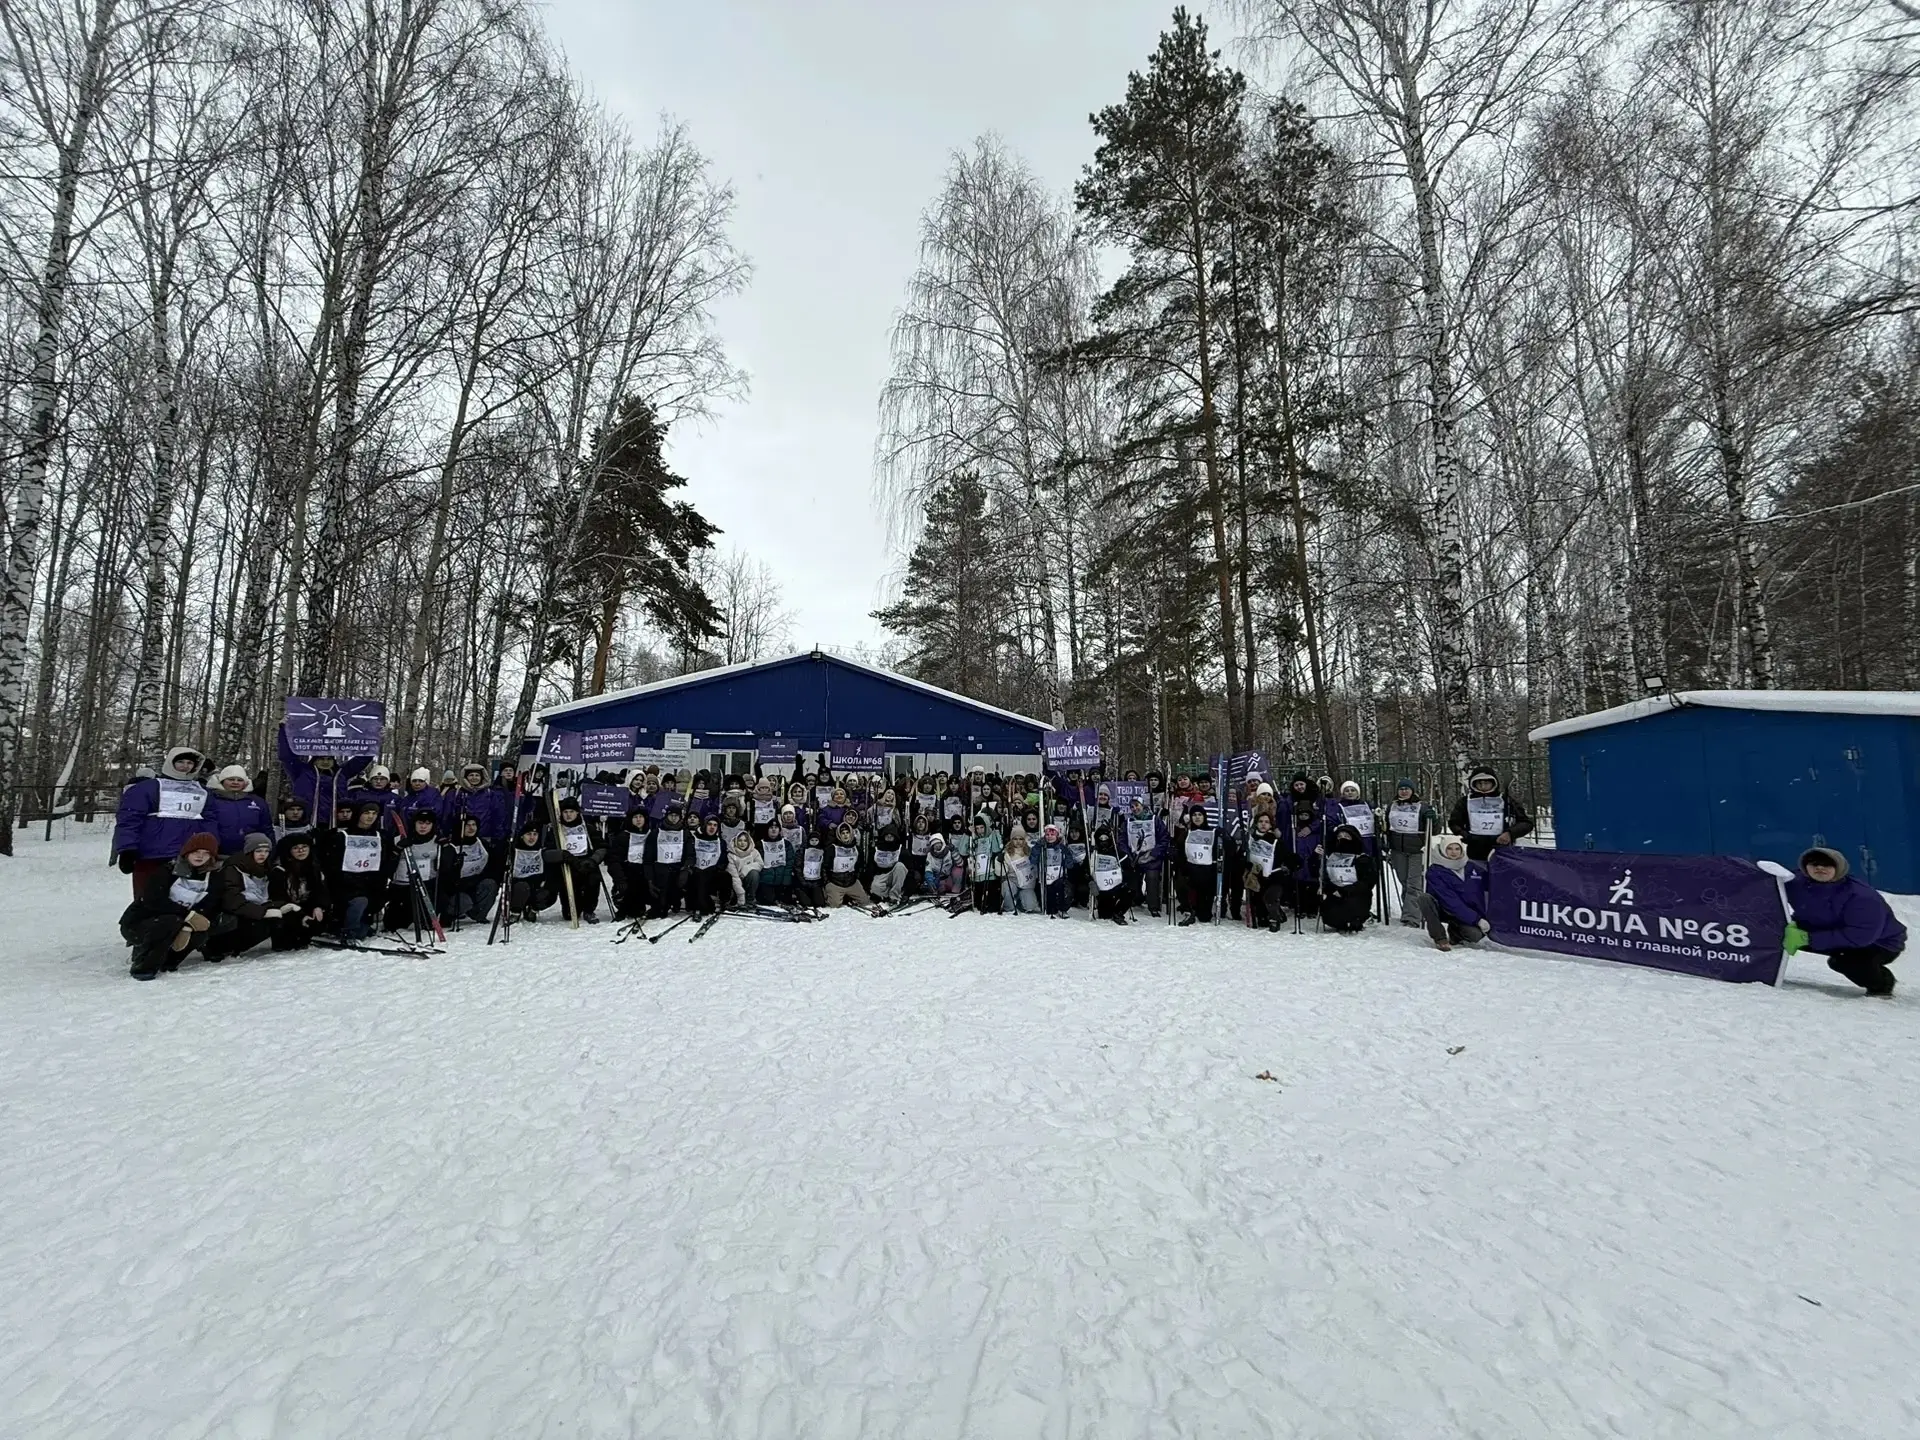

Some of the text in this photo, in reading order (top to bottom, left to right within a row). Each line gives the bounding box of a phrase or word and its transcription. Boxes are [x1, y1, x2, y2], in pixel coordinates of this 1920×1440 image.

[600, 733, 629, 741] трасса.
[600, 741, 633, 749] момент.
[581, 751, 600, 759] Твой
[601, 749, 625, 758] забег.
[832, 756, 883, 765] ШКОЛА №68
[176, 802, 192, 812] 10
[1397, 818, 1409, 828] 52
[1481, 821, 1495, 830] 27
[566, 842, 578, 851] 25
[1193, 851, 1204, 860] 19
[355, 860, 370, 868] 46
[520, 864, 540, 874] 4055
[1103, 878, 1114, 887] 30
[1519, 899, 1751, 948] ШКОЛА №68
[1519, 925, 1750, 963] школа, где ты в главной роли
